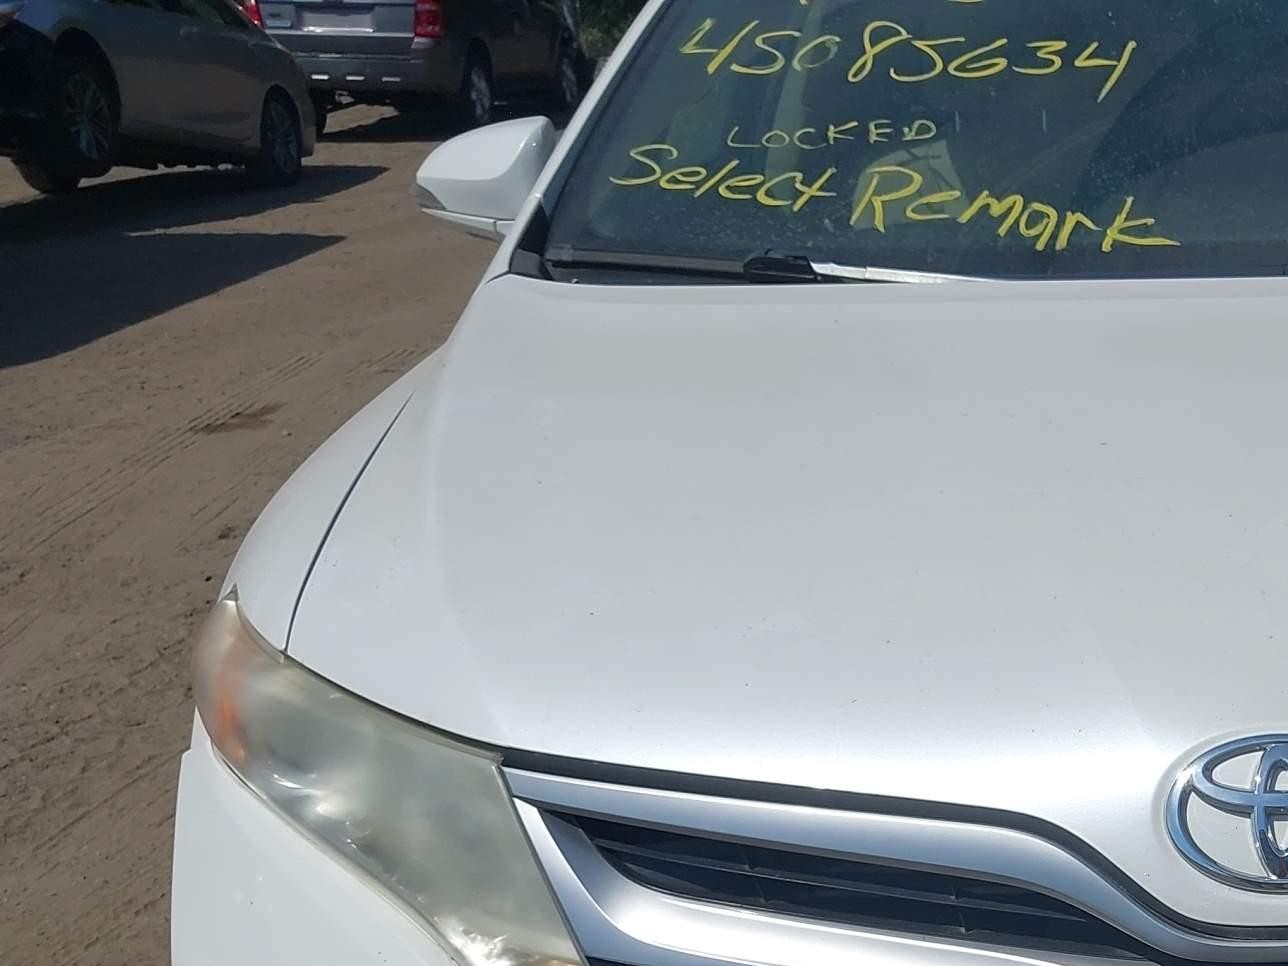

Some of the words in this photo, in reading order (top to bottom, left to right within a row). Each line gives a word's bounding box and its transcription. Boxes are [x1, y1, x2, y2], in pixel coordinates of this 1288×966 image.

[679, 17, 1137, 103] 45085634
[727, 119, 937, 149] LOCKED
[609, 144, 837, 212] Select
[850, 165, 1181, 253] Remark
